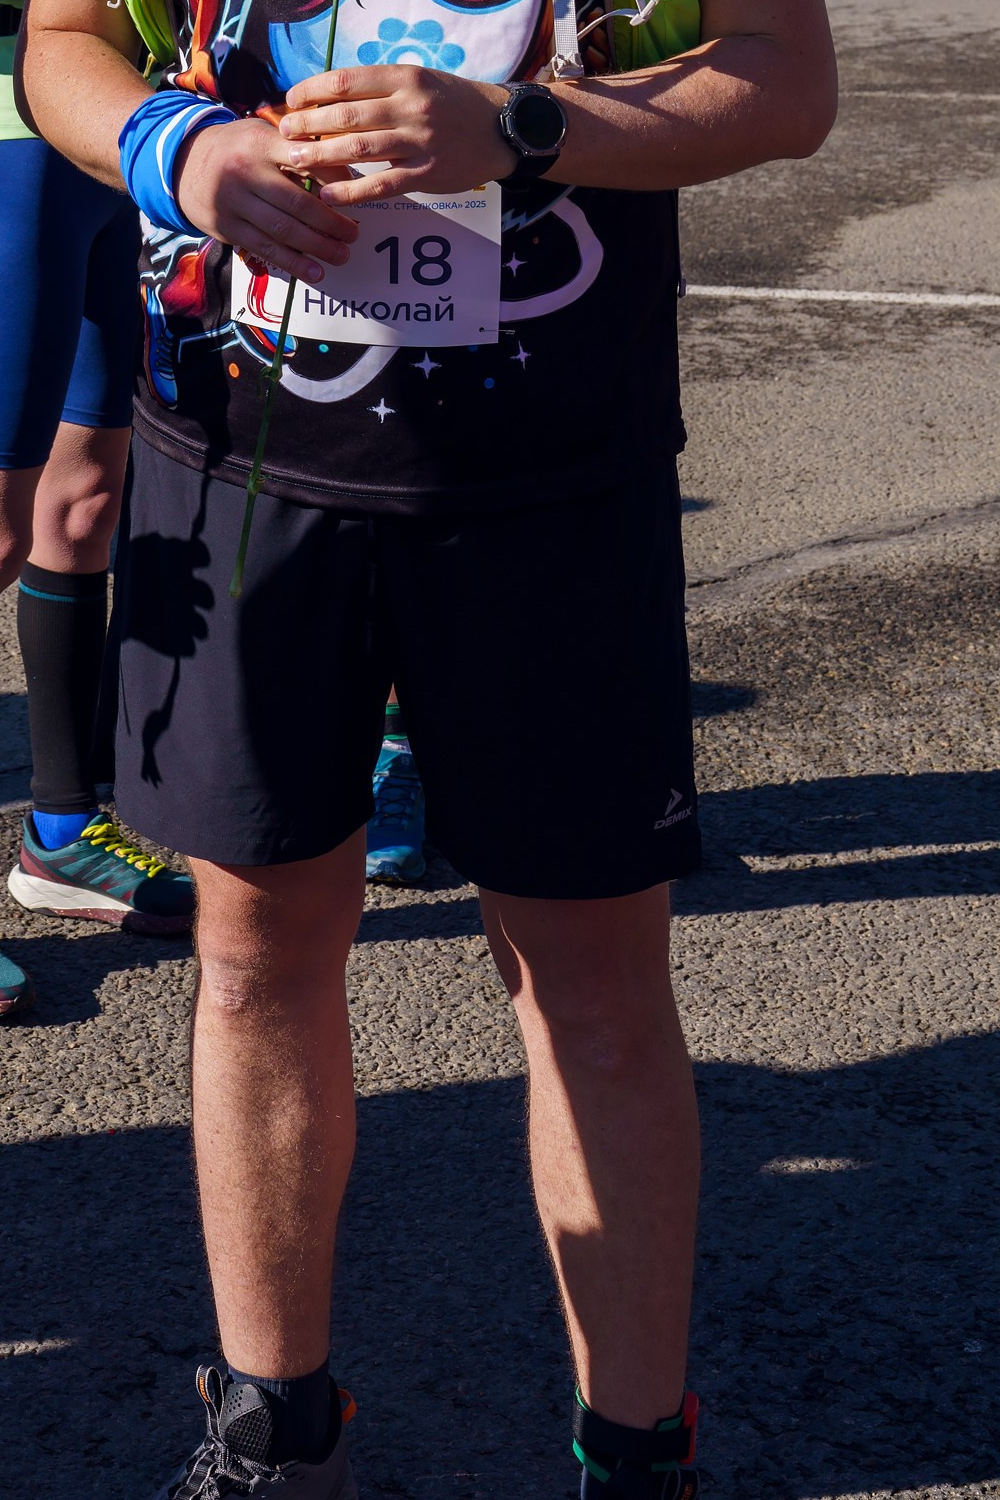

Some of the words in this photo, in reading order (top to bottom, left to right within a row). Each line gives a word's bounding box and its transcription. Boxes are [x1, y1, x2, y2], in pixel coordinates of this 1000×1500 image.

[394, 201, 463, 211] СТРЕЛКОВКА»
[465, 200, 487, 209] 2025
[374, 235, 452, 286] 18
[304, 288, 455, 322] Николай
[653, 805, 693, 830] DEMIX
